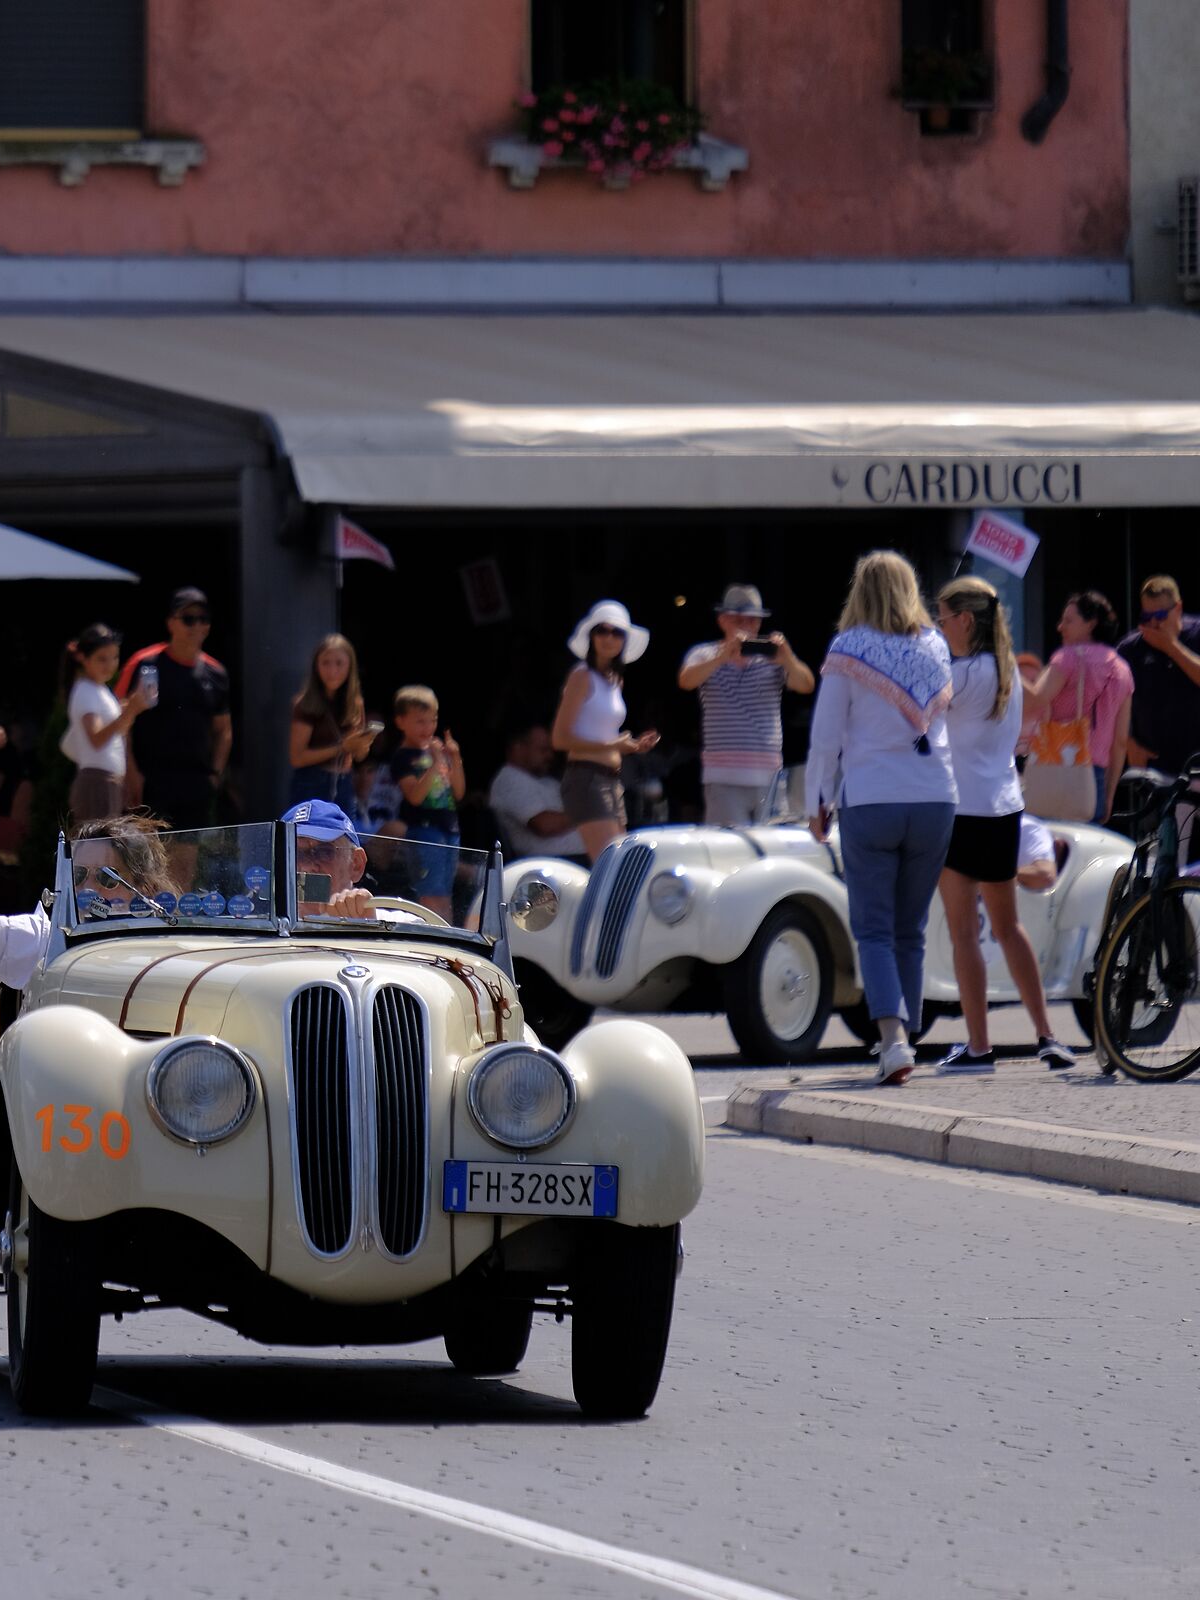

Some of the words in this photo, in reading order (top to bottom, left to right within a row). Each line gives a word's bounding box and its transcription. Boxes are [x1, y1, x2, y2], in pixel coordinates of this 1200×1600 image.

[864, 462, 1082, 504] CARDUCCI
[982, 522, 1019, 549] 1000
[35, 1103, 132, 1161] 130
